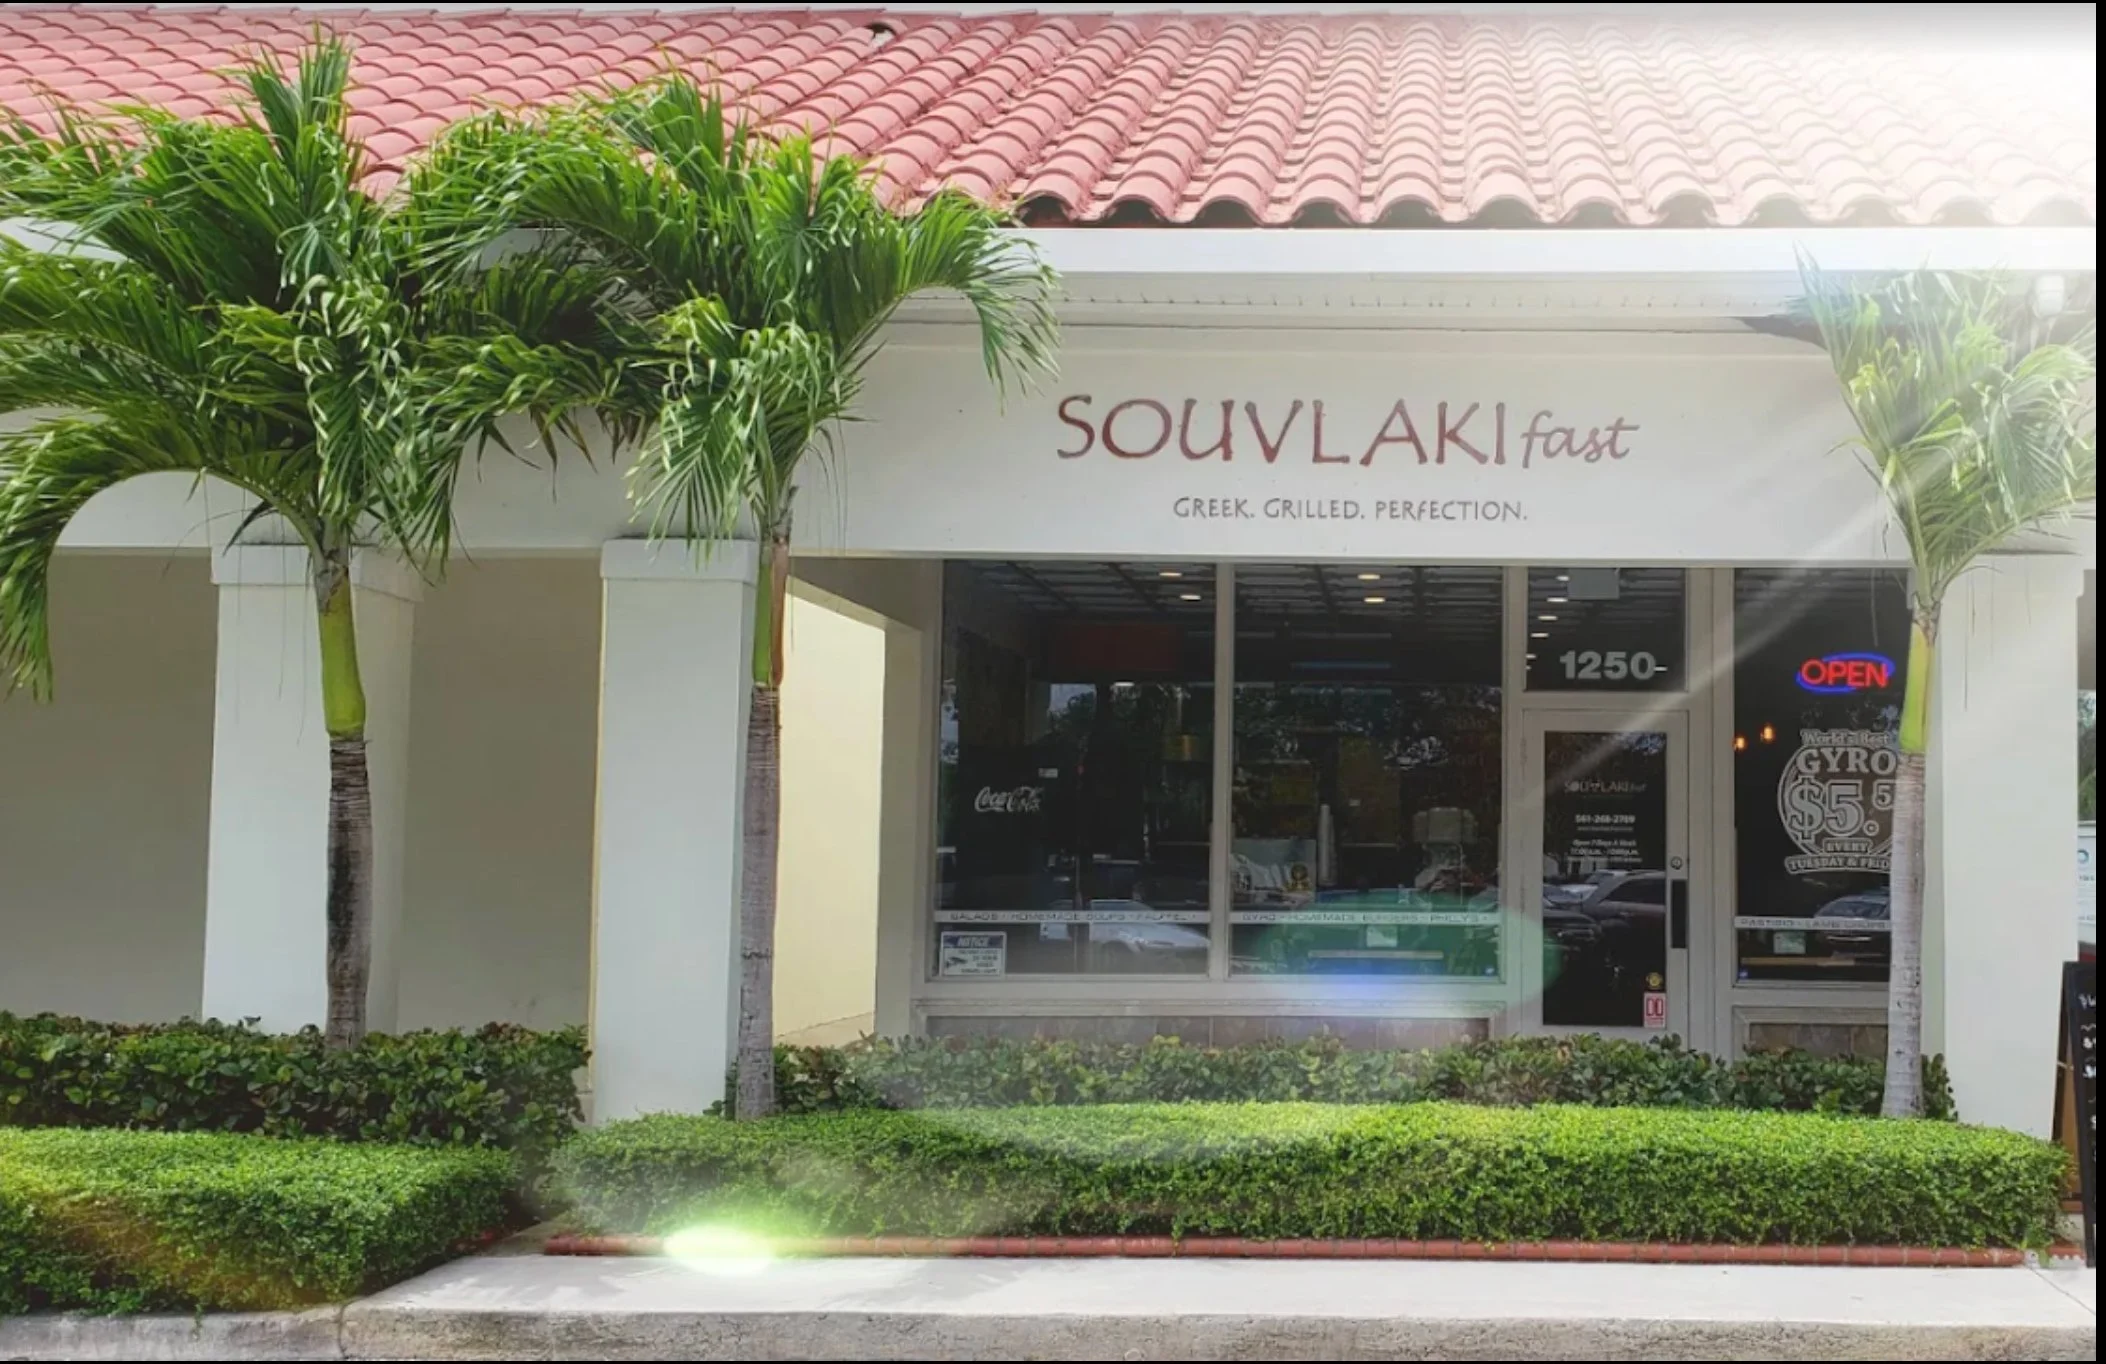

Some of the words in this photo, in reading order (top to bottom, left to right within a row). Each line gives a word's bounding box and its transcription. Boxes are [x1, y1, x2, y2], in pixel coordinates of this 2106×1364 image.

[1057, 394, 1507, 466] SOUVLAKI
[1520, 410, 1640, 469] fast
[1173, 497, 1256, 520] GREEK.
[1264, 497, 1366, 521] GRILLED.
[1375, 499, 1529, 522] PERFECTION.
[1560, 651, 1656, 680] 1250
[1800, 659, 1888, 687] OPEN
[1860, 731, 1889, 746] Best
[1796, 748, 1897, 775] GYRO
[1826, 842, 1869, 852] EVERY
[1788, 856, 1844, 869] TUESDAY
[1861, 857, 1890, 868] FRID
